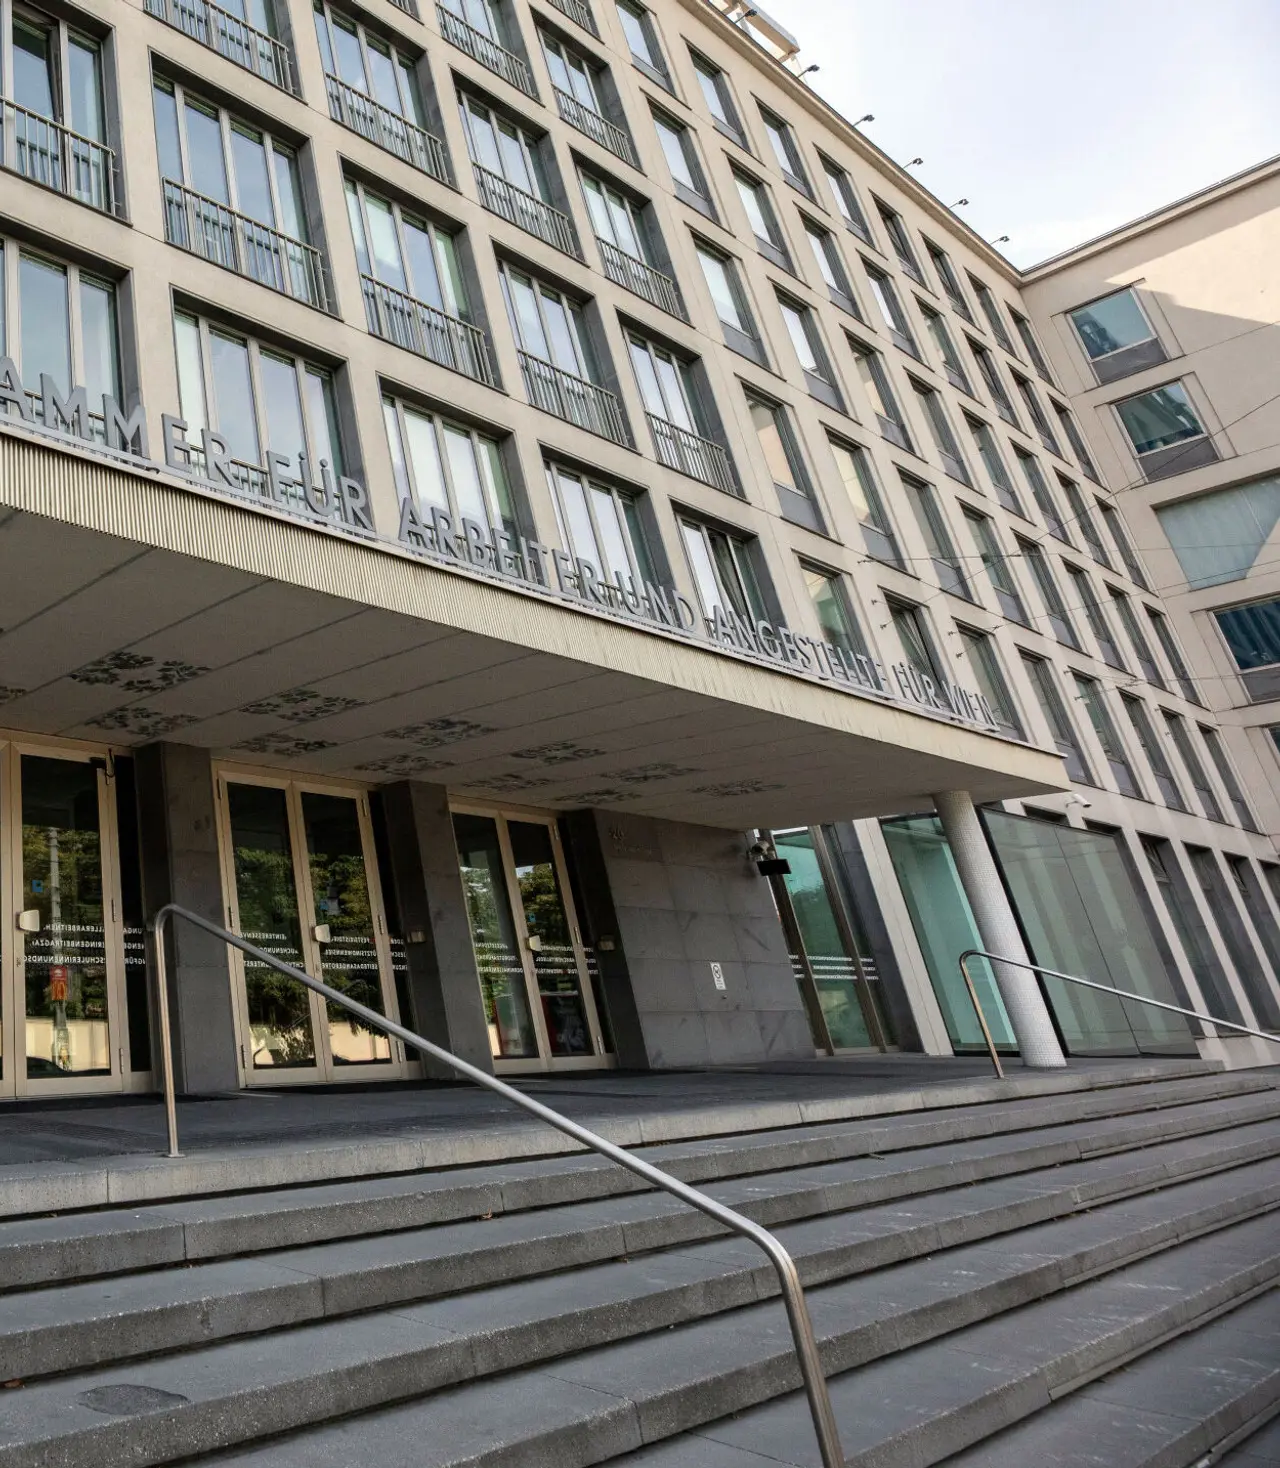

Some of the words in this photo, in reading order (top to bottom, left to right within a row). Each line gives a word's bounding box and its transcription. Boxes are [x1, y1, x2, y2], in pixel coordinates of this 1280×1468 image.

[266, 451, 376, 532] FÜR
[398, 497, 604, 606] ARBEITER
[615, 570, 699, 632] UND
[712, 604, 888, 691] ANGESTELLTE
[891, 661, 941, 709] FÜR
[940, 680, 1000, 732] WIEN
